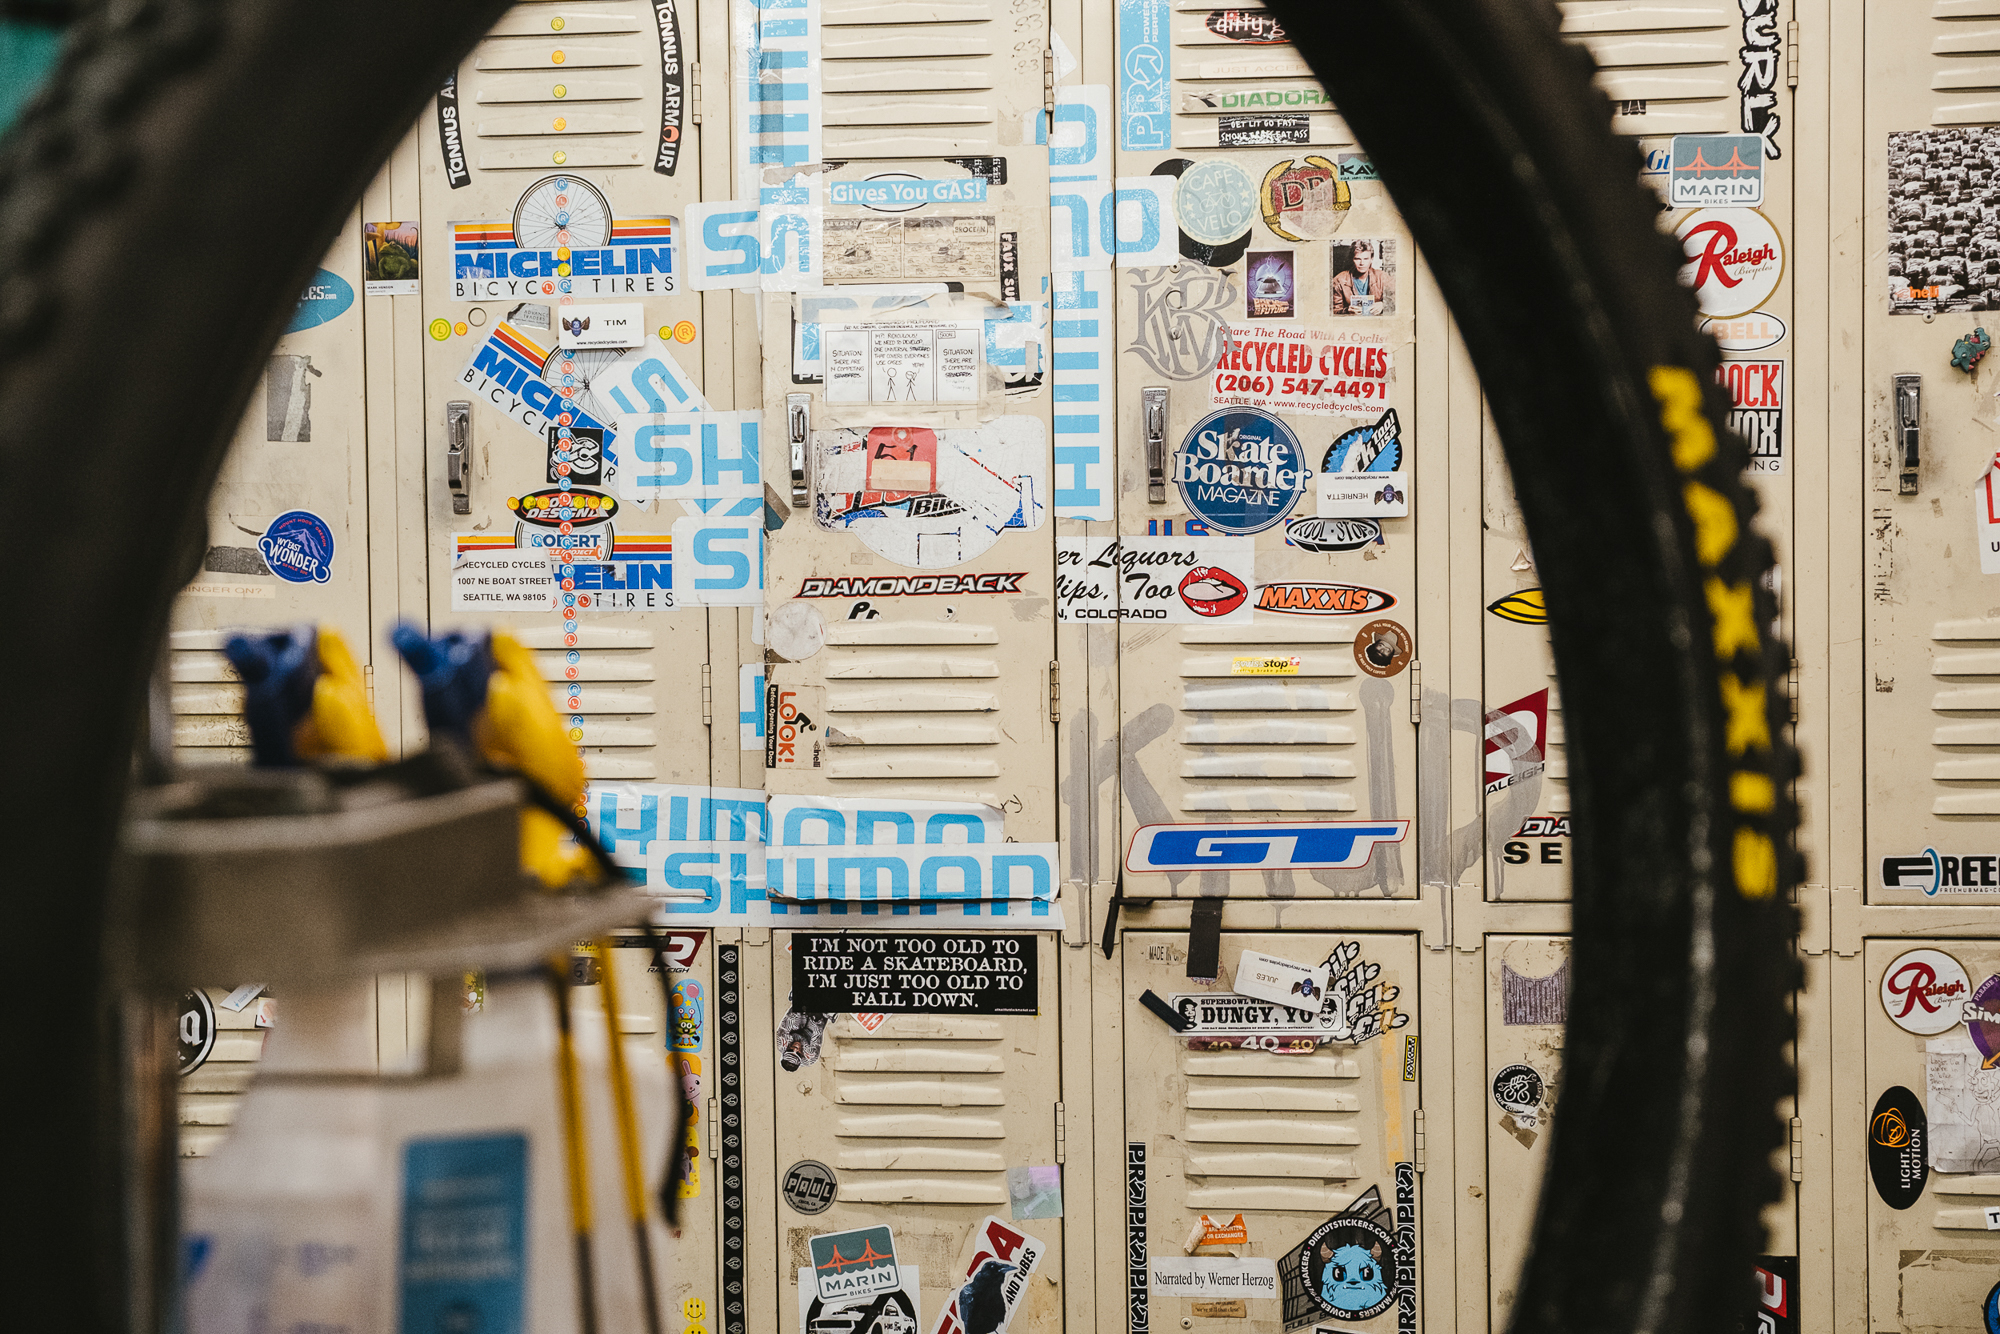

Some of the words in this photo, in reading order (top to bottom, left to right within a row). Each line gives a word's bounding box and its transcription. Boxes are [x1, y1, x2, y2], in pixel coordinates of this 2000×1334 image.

[1216, 10, 1263, 36] dirty
[1213, 66, 1247, 74] JUST
[1277, 119, 1297, 127] FAST
[1294, 130, 1308, 139] ASS
[832, 184, 887, 203] Gives
[892, 184, 928, 201] You
[933, 182, 982, 200] GAS!
[1681, 184, 1753, 196] MARIN
[1197, 211, 1243, 233] VELO
[1002, 233, 1014, 272] FAUX
[592, 276, 675, 293] TIRES
[1220, 326, 1251, 337] Share
[1254, 328, 1275, 338] The
[1278, 328, 1305, 340] Road
[1310, 331, 1335, 341] With
[1338, 332, 1346, 341] A
[1712, 322, 1774, 339] BELL
[1217, 340, 1313, 374] RECYCLED
[1319, 345, 1388, 379] CYCLES
[1215, 374, 1274, 396] (206)
[1281, 378, 1386, 400] 547-4491
[1273, 401, 1384, 413] www.recycledcycles.com
[1197, 428, 1289, 466] Skate
[1172, 452, 1313, 492] Boarder
[1198, 485, 1281, 507] MAGAZINE
[1294, 520, 1327, 541] KOOL
[1336, 520, 1368, 542] STOP
[263, 540, 322, 578] WONDER
[462, 561, 509, 569] RECYCLED
[511, 561, 546, 569] CYCLES
[1088, 542, 1199, 570] Liquors
[478, 577, 490, 585] NE
[492, 577, 516, 585] BOAT
[518, 577, 552, 585] STREET
[801, 573, 1019, 597] DIAMONDBACK
[1125, 573, 1176, 600] Too
[463, 593, 504, 602] SEATTLE,
[506, 593, 521, 601] WA
[522, 593, 547, 601] 98105
[596, 592, 674, 607] TIRES
[1259, 587, 1370, 611] MAXXIS
[1075, 608, 1167, 619] COLORADO
[768, 687, 776, 706] Before
[768, 708, 776, 732] Opening
[778, 691, 797, 763] LOOK!
[768, 734, 776, 750] Your
[767, 751, 775, 766] Door
[1487, 762, 1546, 796] ALEIGH
[810, 938, 840, 953] I'M
[846, 939, 888, 953] NOT
[894, 939, 936, 953] TOO
[943, 939, 986, 954] OLD
[992, 940, 1019, 954] TO
[1149, 945, 1165, 961] MADE
[803, 956, 854, 970] RIDE
[860, 957, 877, 970] A
[884, 957, 1028, 975] SKATEBOARD,
[807, 974, 837, 988] I'M
[843, 974, 891, 989] JUST
[898, 974, 940, 989] TOO
[947, 975, 990, 990] OLD
[996, 976, 1023, 990] TO
[1256, 972, 1279, 984] JULES
[851, 992, 906, 1007] FALL
[913, 992, 979, 1008] DOWN.
[1888, 962, 1967, 1019] Raleigh
[1201, 1006, 1279, 1026] DUNGY,
[1240, 1036, 1280, 1050] 40
[1289, 1039, 1314, 1049] 40
[1912, 1128, 1921, 1180] MOTION
[1901, 1152, 1910, 1189] LIGHT
[788, 1177, 831, 1198] PAUL
[1309, 1218, 1393, 1247] DIECUTSTICKERS.COM
[1006, 1280, 1021, 1305] AND
[1014, 1247, 1036, 1282] TUBES
[1301, 1250, 1311, 1287] MAKERS
[826, 1271, 892, 1292] MARIN
[1155, 1271, 1192, 1286] Narrated
[1194, 1272, 1205, 1288] by
[1208, 1272, 1240, 1286] Werner
[1242, 1272, 1274, 1289] Herzog
[850, 1288, 872, 1296] BIKES
[1321, 1303, 1351, 1319] POWER
[1358, 1298, 1393, 1319] MAKERS
